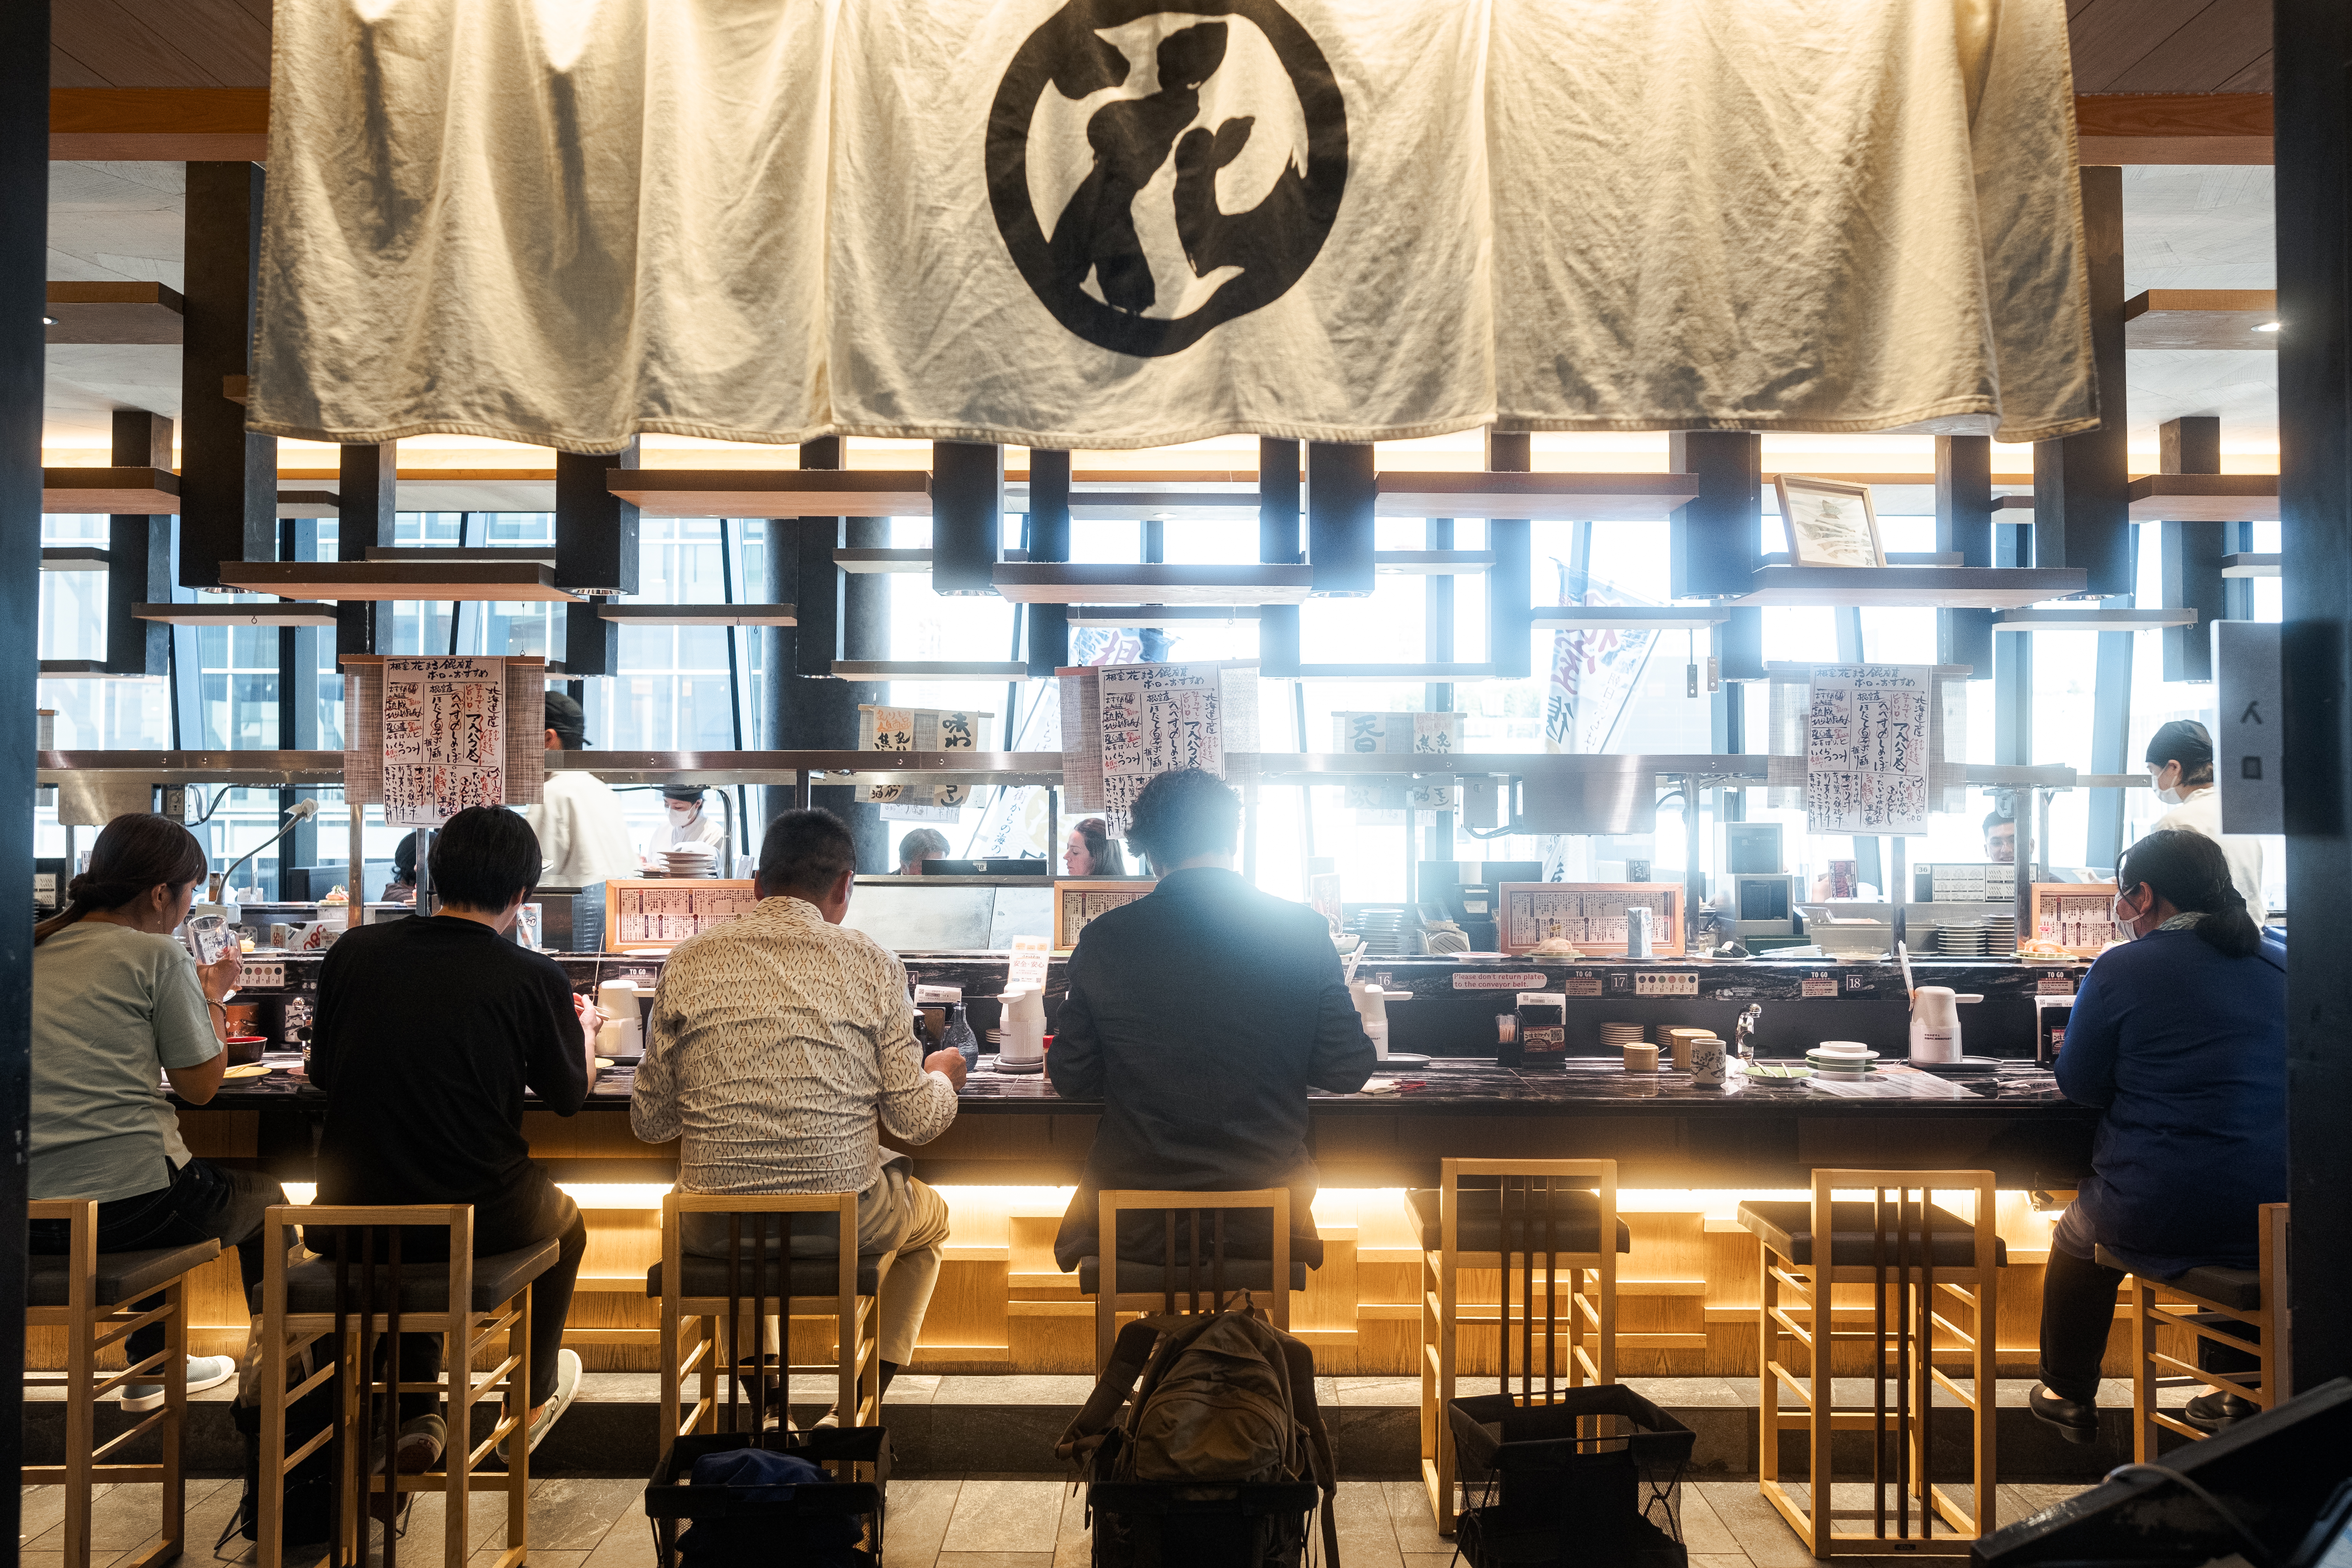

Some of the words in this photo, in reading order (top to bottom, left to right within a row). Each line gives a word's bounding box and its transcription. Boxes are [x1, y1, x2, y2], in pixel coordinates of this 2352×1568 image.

[390, 659, 474, 671] 根室花まる銀座店
[428, 669, 489, 680] 本日のおすすめ
[1106, 666, 1188, 681] 根室花まる銀座店
[1816, 667, 1900, 678] 根室花まる銀座店
[1143, 676, 1205, 689] 本日のおすすめ
[1855, 677, 1915, 687] 本日のおすすめ
[486, 686, 502, 727] 北海道産
[1203, 692, 1219, 734] 北海道産
[1912, 696, 1928, 737] 北海道産
[1378, 975, 1390, 986] 16
[1613, 977, 1625, 987] 17
[1849, 978, 1860, 988] 18
